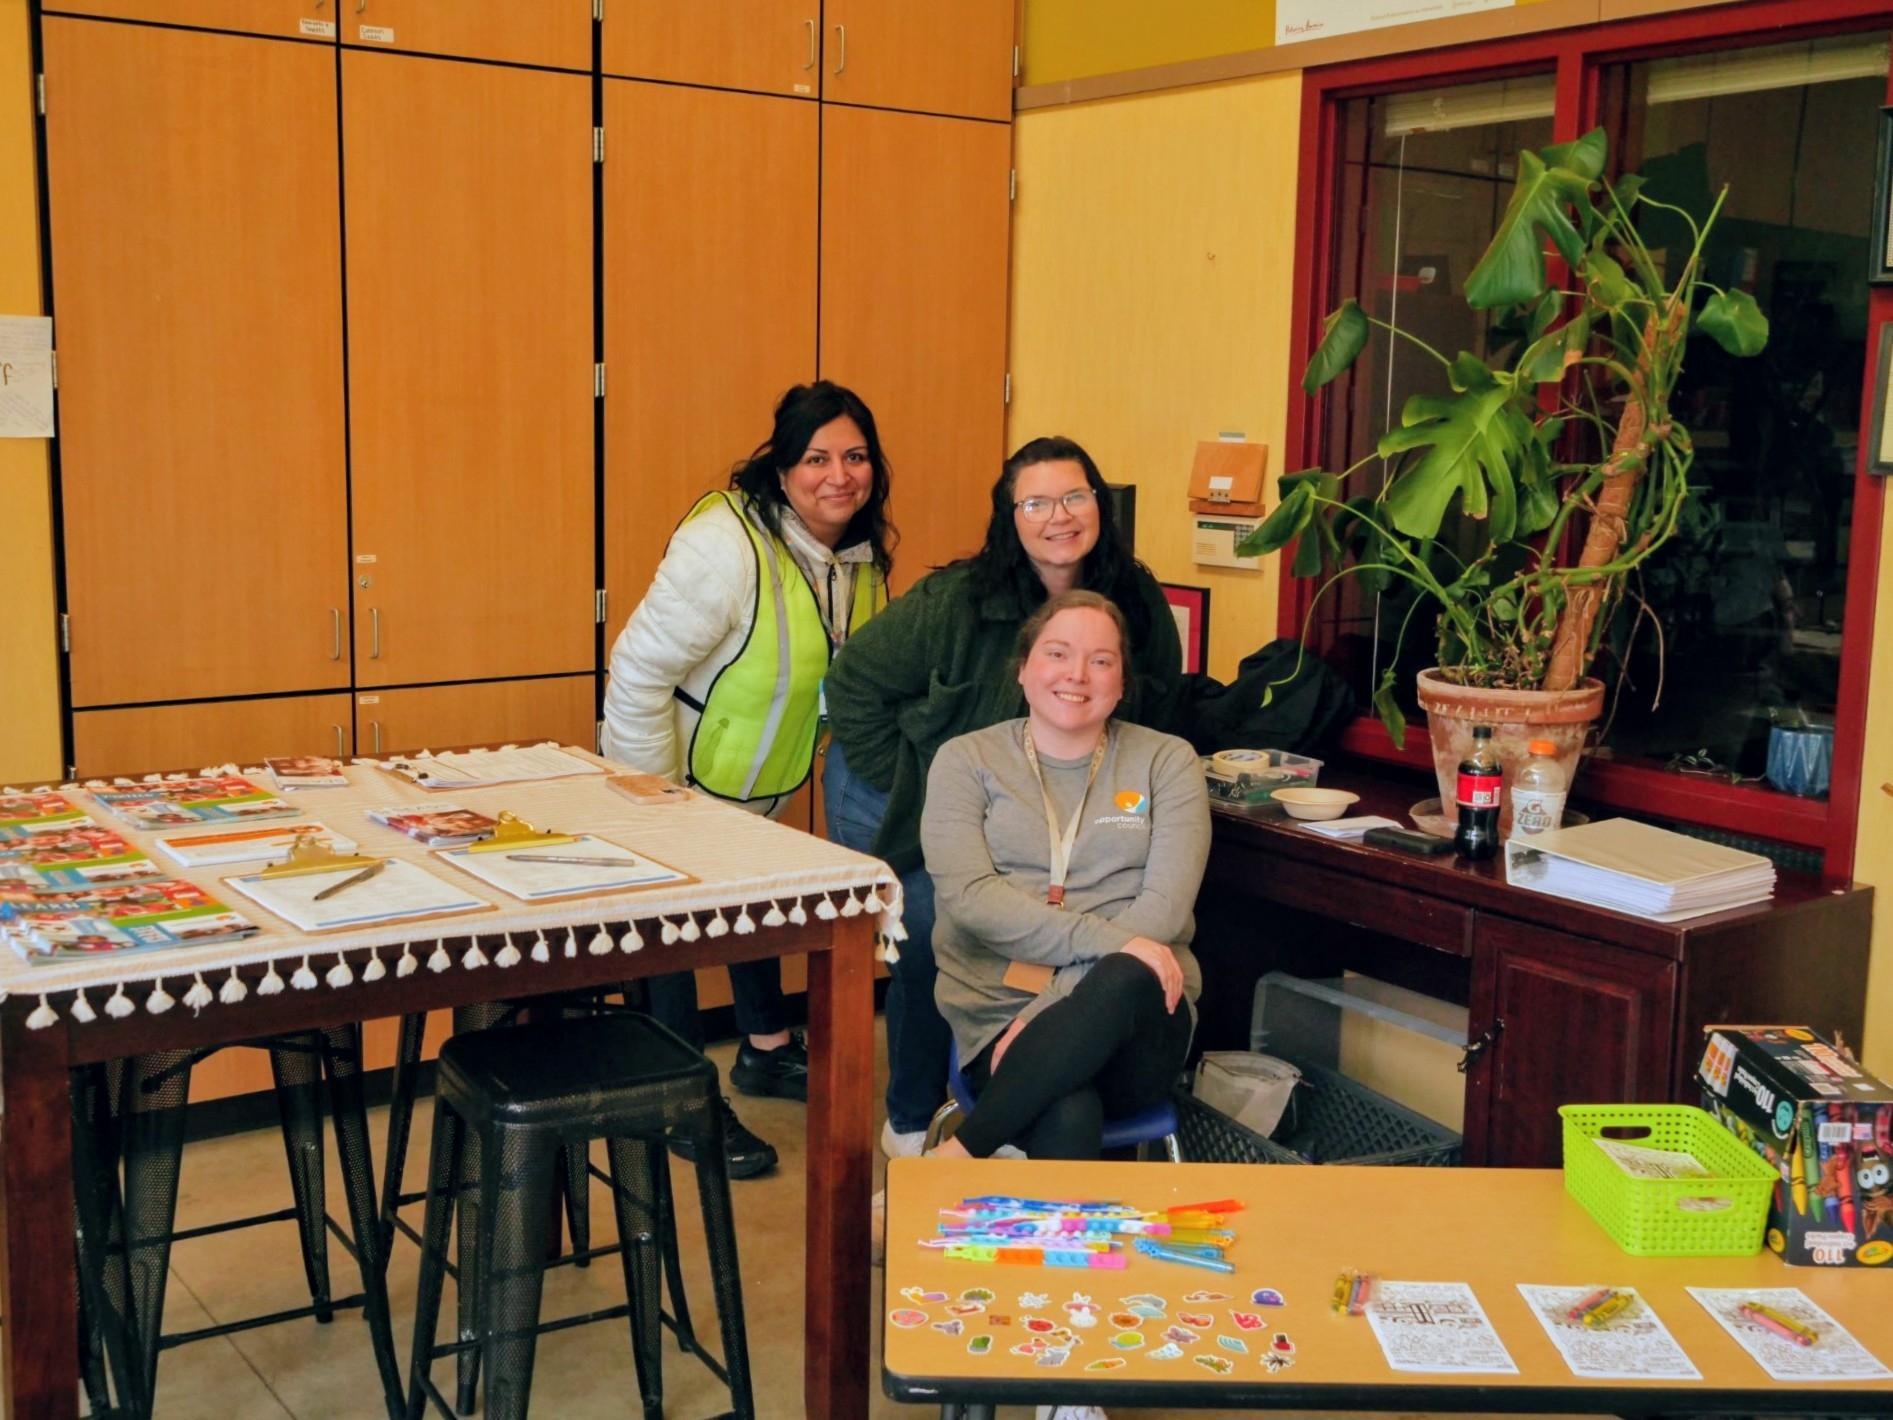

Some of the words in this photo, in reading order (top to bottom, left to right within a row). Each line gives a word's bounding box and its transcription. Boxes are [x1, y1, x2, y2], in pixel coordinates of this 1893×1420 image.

[1094, 815, 1145, 825] opportunity
[1517, 812, 1552, 828] ZERO
[1813, 1247, 1845, 1264] 110
